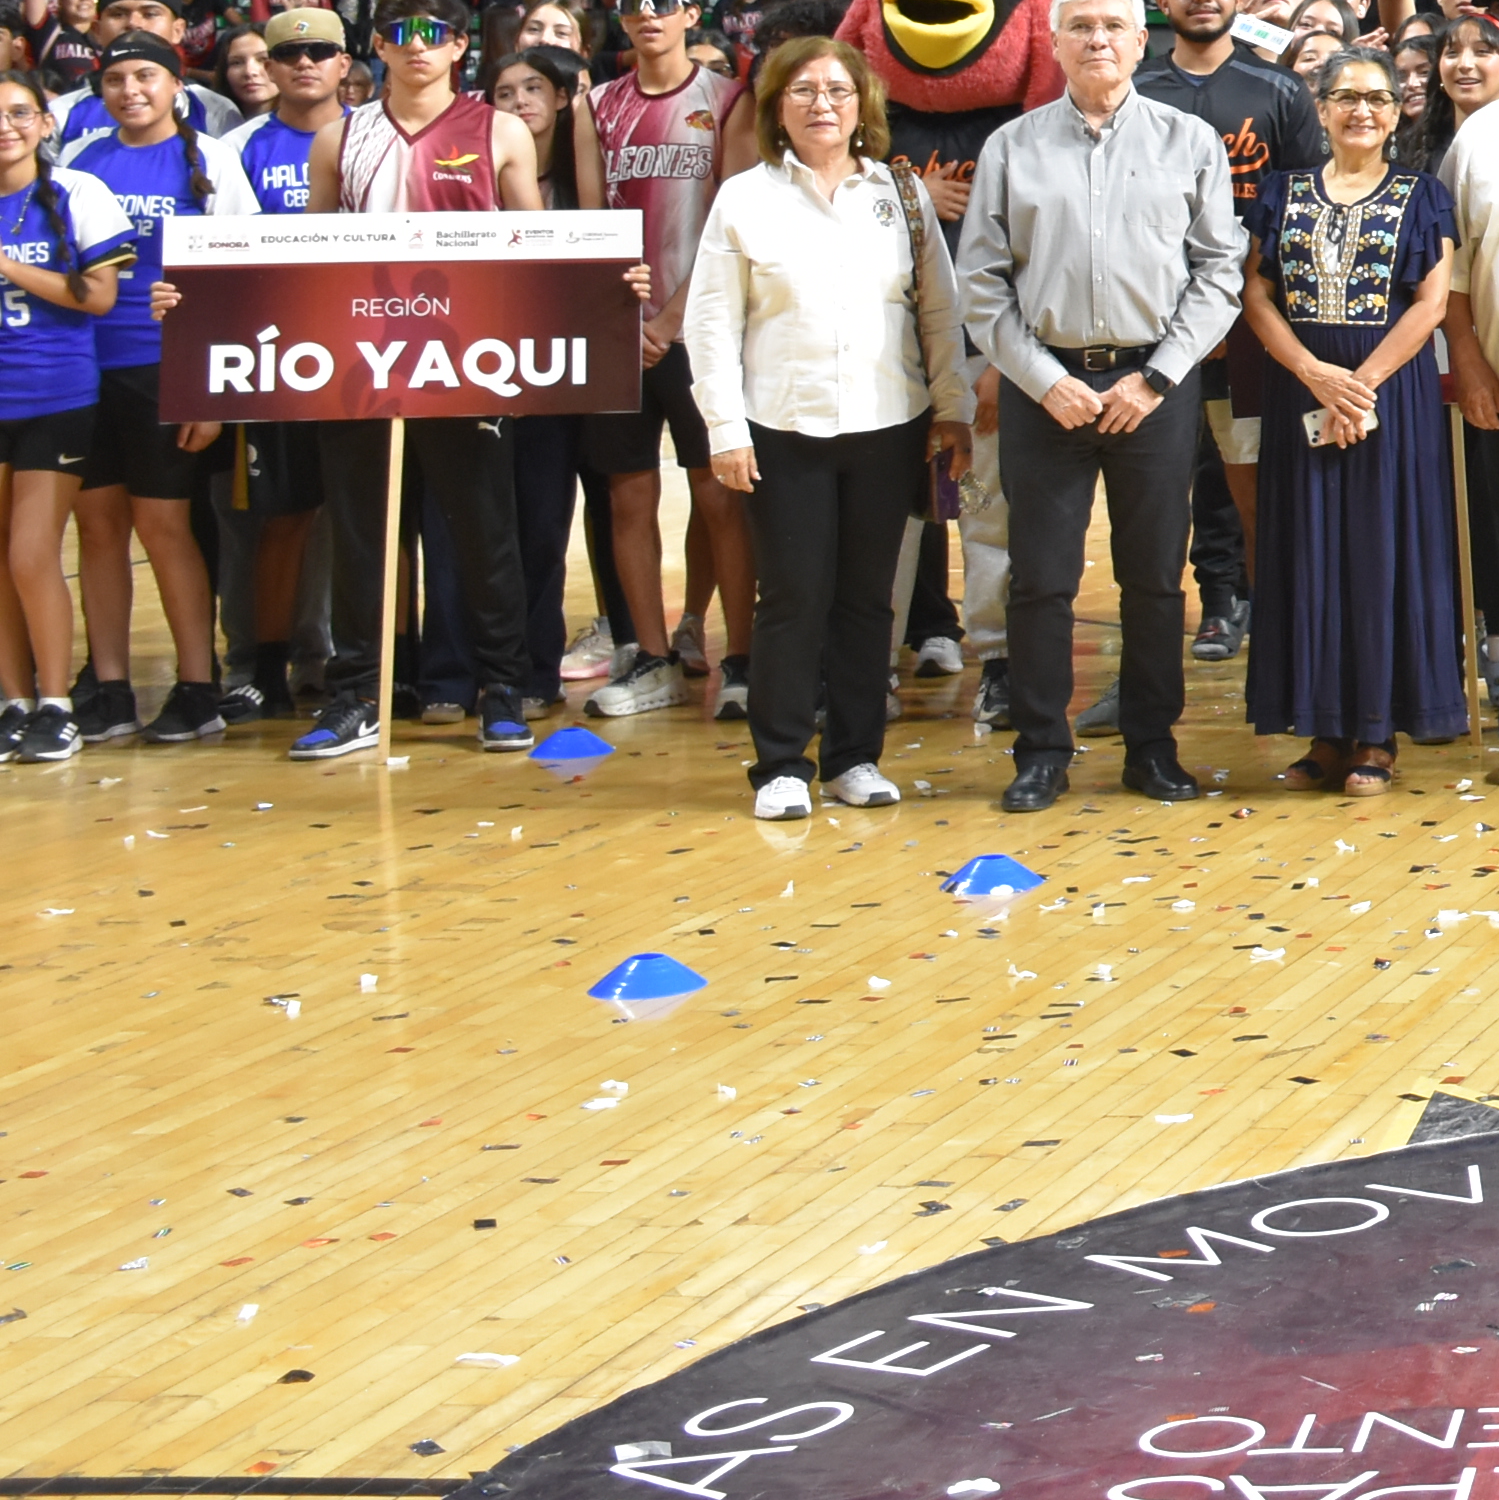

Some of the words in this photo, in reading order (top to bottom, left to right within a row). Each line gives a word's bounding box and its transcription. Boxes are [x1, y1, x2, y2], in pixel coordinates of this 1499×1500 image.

[606, 144, 712, 183] LEONES
[208, 241, 250, 249] SONORA
[261, 233, 328, 244] EDUCACIÓN
[344, 234, 396, 242] CULTURA
[436, 230, 497, 239] Bachillerato
[436, 239, 478, 247] Nacional
[351, 293, 450, 317] REGIÓN
[208, 324, 334, 393] RÍO
[355, 338, 587, 397] YAQUI
[811, 1288, 1094, 1376] EN
